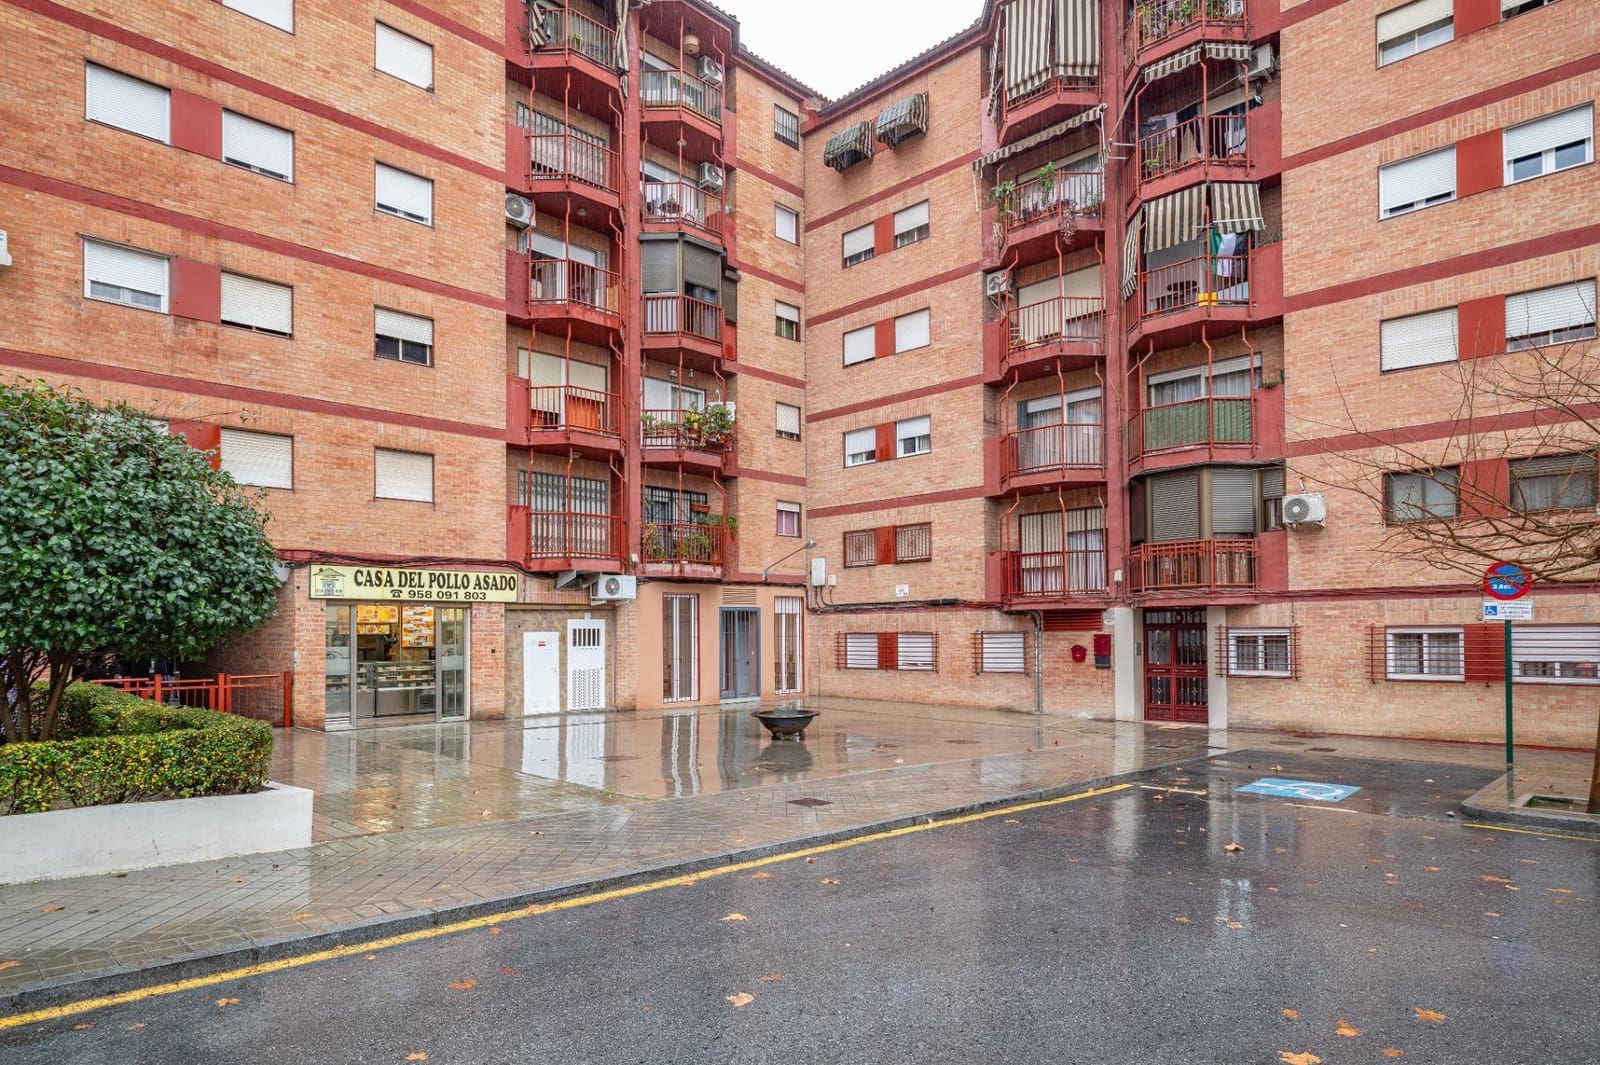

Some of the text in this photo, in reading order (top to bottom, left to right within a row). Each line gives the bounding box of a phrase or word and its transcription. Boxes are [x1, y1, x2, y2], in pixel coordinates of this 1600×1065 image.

[354, 569, 516, 591] CASA DEL POLLO ASADO
[408, 590, 487, 601] 958 091 803
